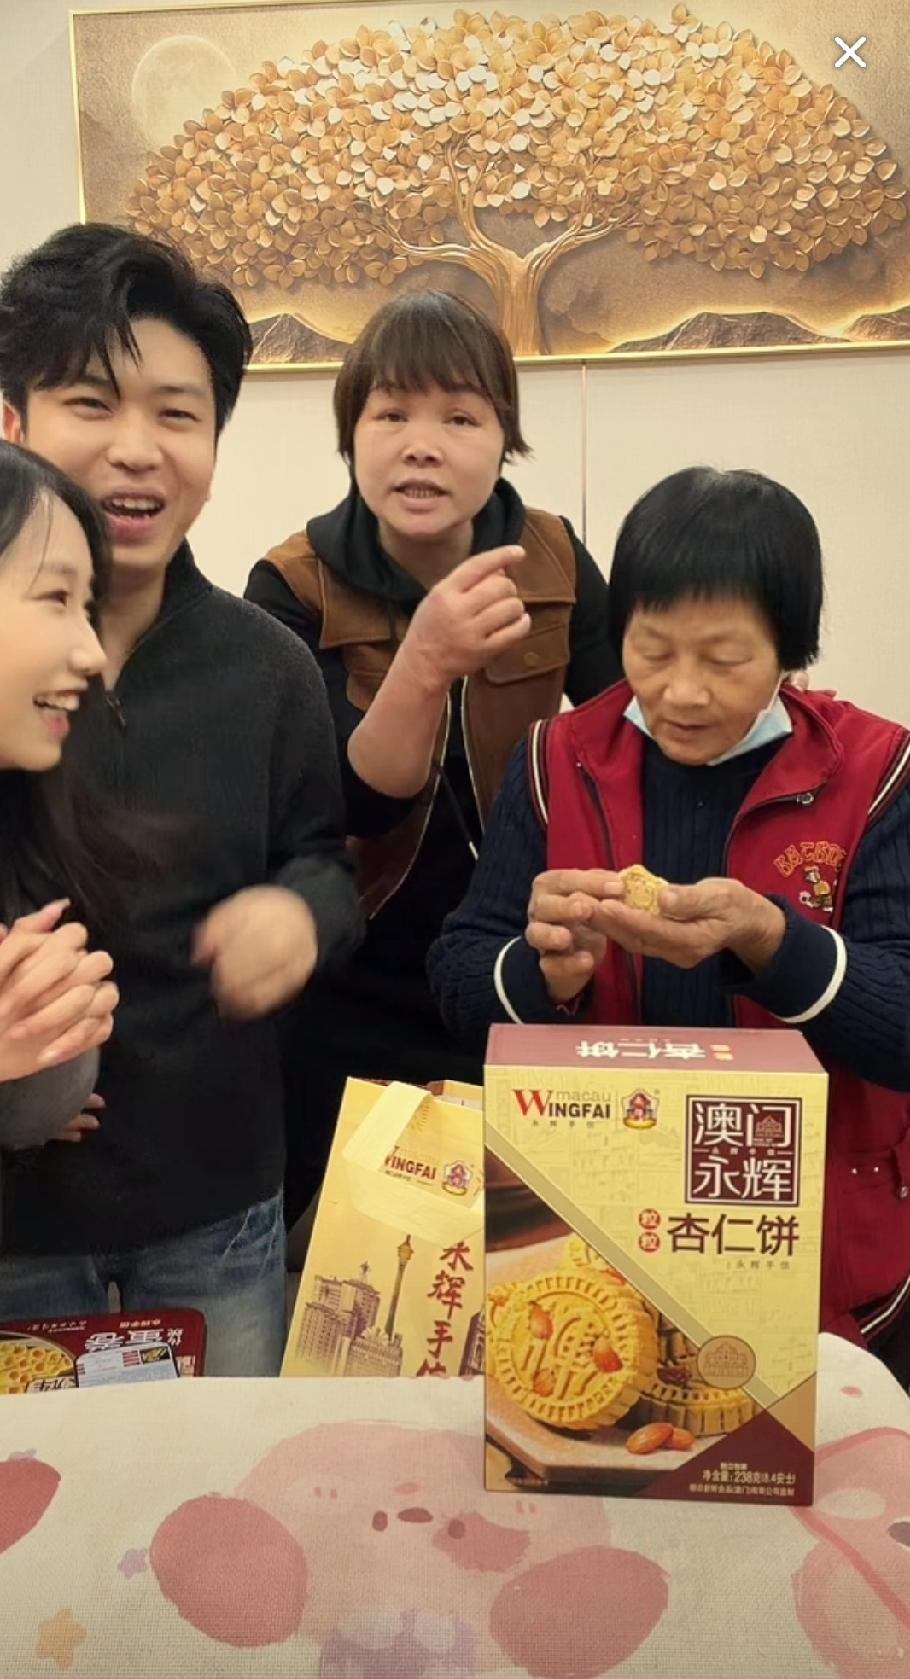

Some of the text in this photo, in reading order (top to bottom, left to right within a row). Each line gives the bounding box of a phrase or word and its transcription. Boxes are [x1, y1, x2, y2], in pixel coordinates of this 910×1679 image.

[576, 1040, 706, 1060] 杏仁饼
[512, 1089, 611, 1119] WINGFAI
[556, 1090, 611, 1102] macau
[694, 1102, 792, 1148] 澳门
[693, 1154, 792, 1201] 永辉
[667, 1212, 799, 1256] 杏仁饼
